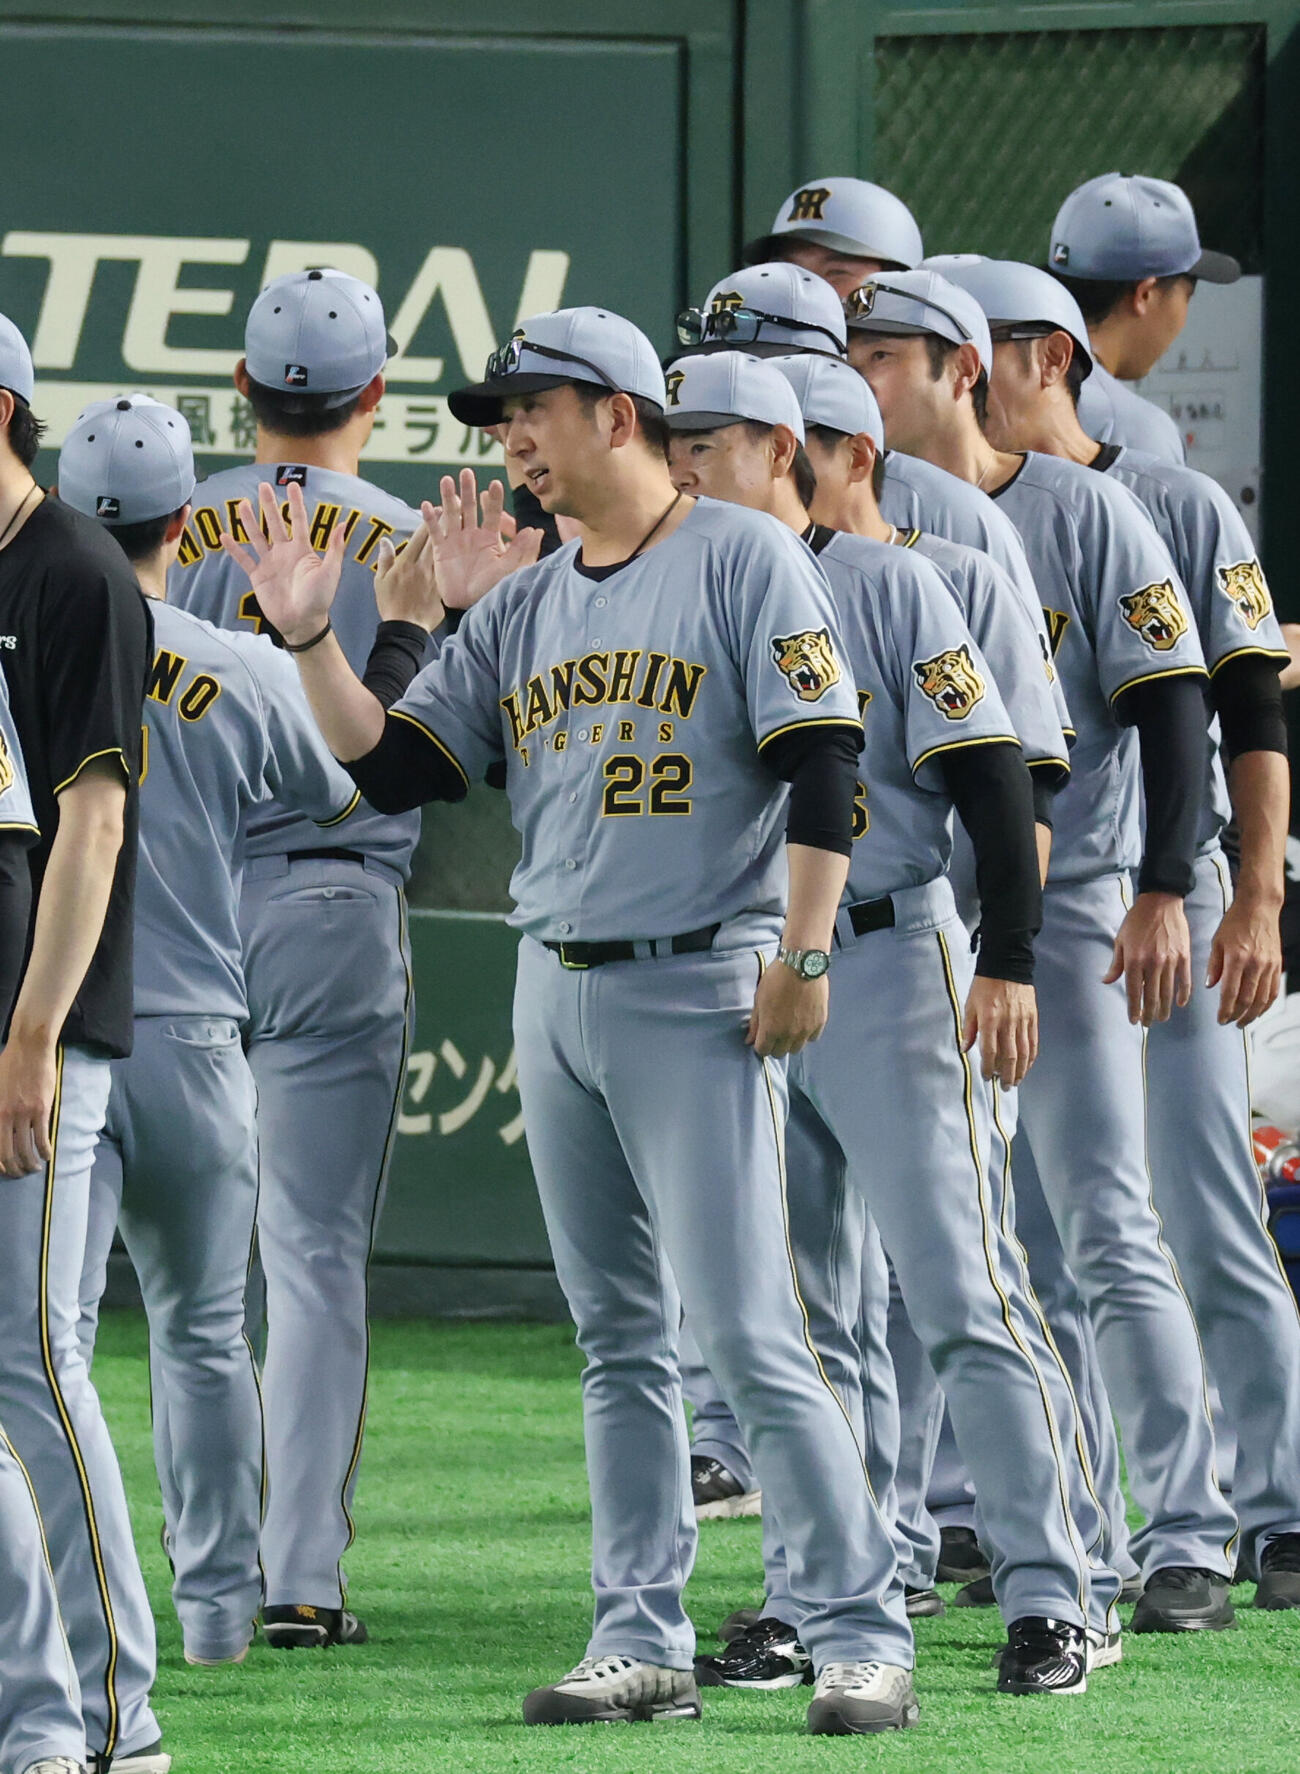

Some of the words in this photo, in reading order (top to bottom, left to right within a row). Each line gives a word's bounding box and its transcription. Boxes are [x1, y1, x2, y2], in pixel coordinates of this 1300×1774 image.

[501, 650, 708, 748] HANSHIN
[520, 720, 674, 767] TGERS
[601, 753, 693, 818] 22
